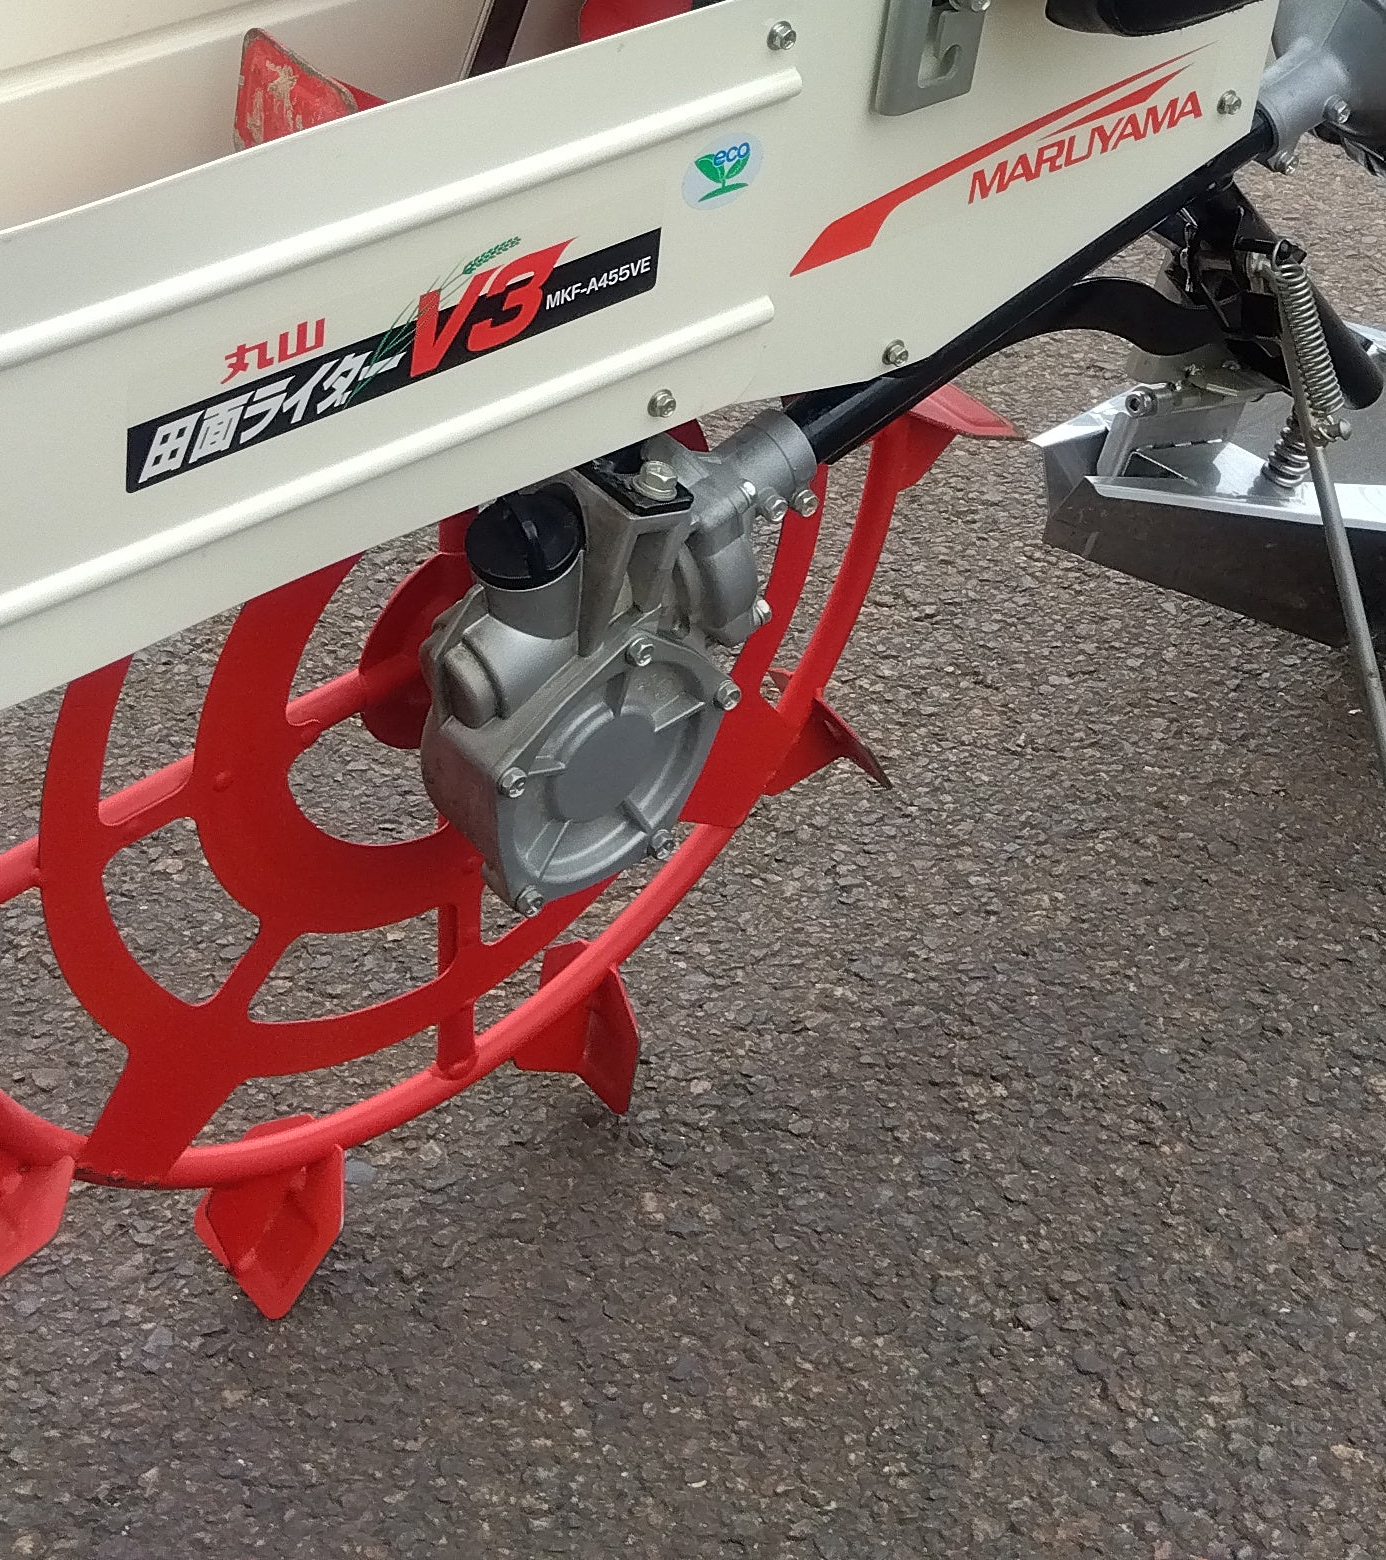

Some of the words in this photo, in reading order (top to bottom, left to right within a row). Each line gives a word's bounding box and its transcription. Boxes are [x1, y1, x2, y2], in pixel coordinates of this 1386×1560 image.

[713, 142, 750, 167] eco
[967, 91, 1202, 204] MARUYAMA
[220, 317, 326, 385] 丸山
[410, 238, 578, 377] V3
[545, 256, 652, 310] MKF-A455VE
